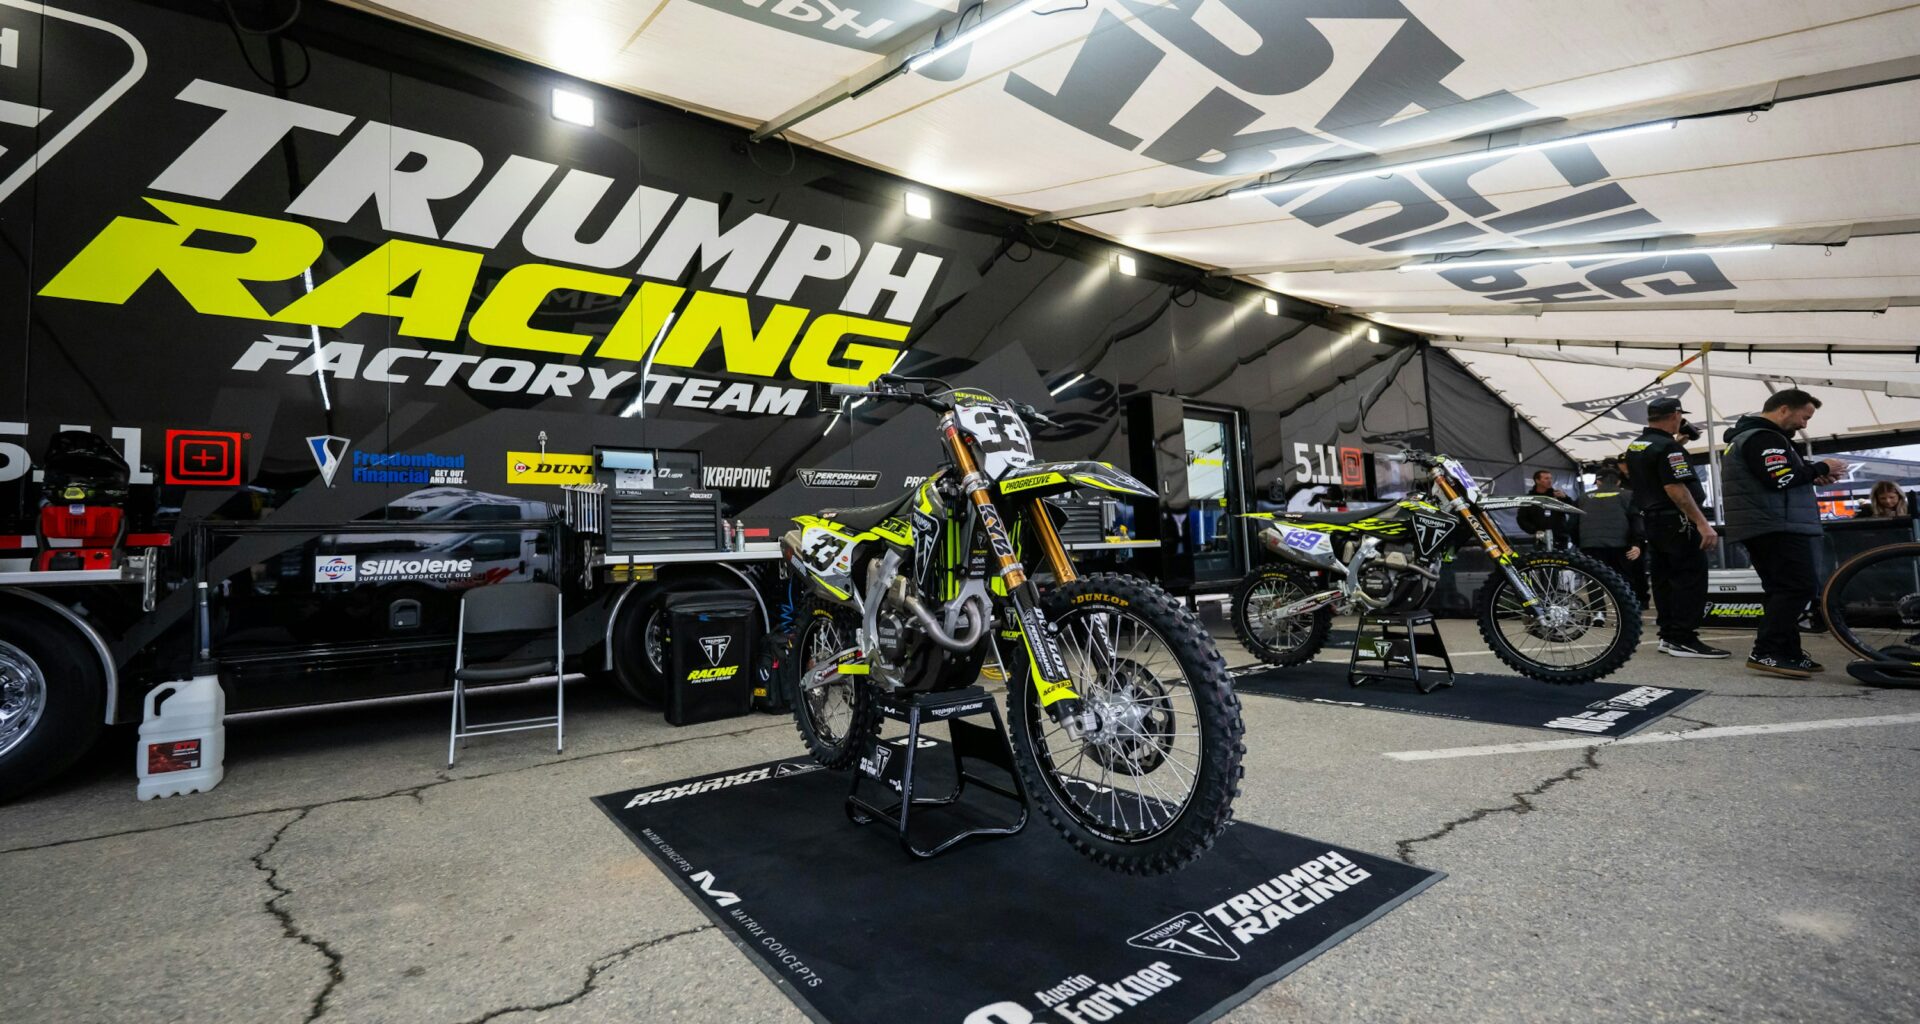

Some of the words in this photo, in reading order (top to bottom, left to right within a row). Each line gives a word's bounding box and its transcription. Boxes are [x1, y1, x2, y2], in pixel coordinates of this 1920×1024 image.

[147, 78, 943, 323] TRIUMPH
[37, 196, 911, 385] RACING
[231, 334, 637, 400] FACTORY
[644, 374, 807, 416] TEAM
[353, 450, 465, 468] FreedomRoad
[1294, 442, 1342, 485] 5.11
[353, 468, 430, 483] Financial
[430, 476, 445, 484] AND
[434, 469, 448, 477] GET
[816, 472, 878, 481] PERFORMANCE
[1004, 475, 1050, 491] PROGRESSIVE
[1418, 516, 1446, 528] TRIUMPH
[318, 565, 353, 573] FUCHS
[360, 559, 472, 576] Silkolene
[1077, 593, 1129, 607] DUNLOP
[686, 665, 739, 681] RACING
[1204, 850, 1351, 927] TRIUMPH
[1231, 864, 1372, 944] RACING
[1142, 919, 1191, 943] TRIUMPH
[730, 908, 766, 937] MATRIX
[762, 936, 823, 988] CONCEPTS
[1034, 973, 1097, 1008] Austin
[1052, 961, 1182, 1024] Forkner
